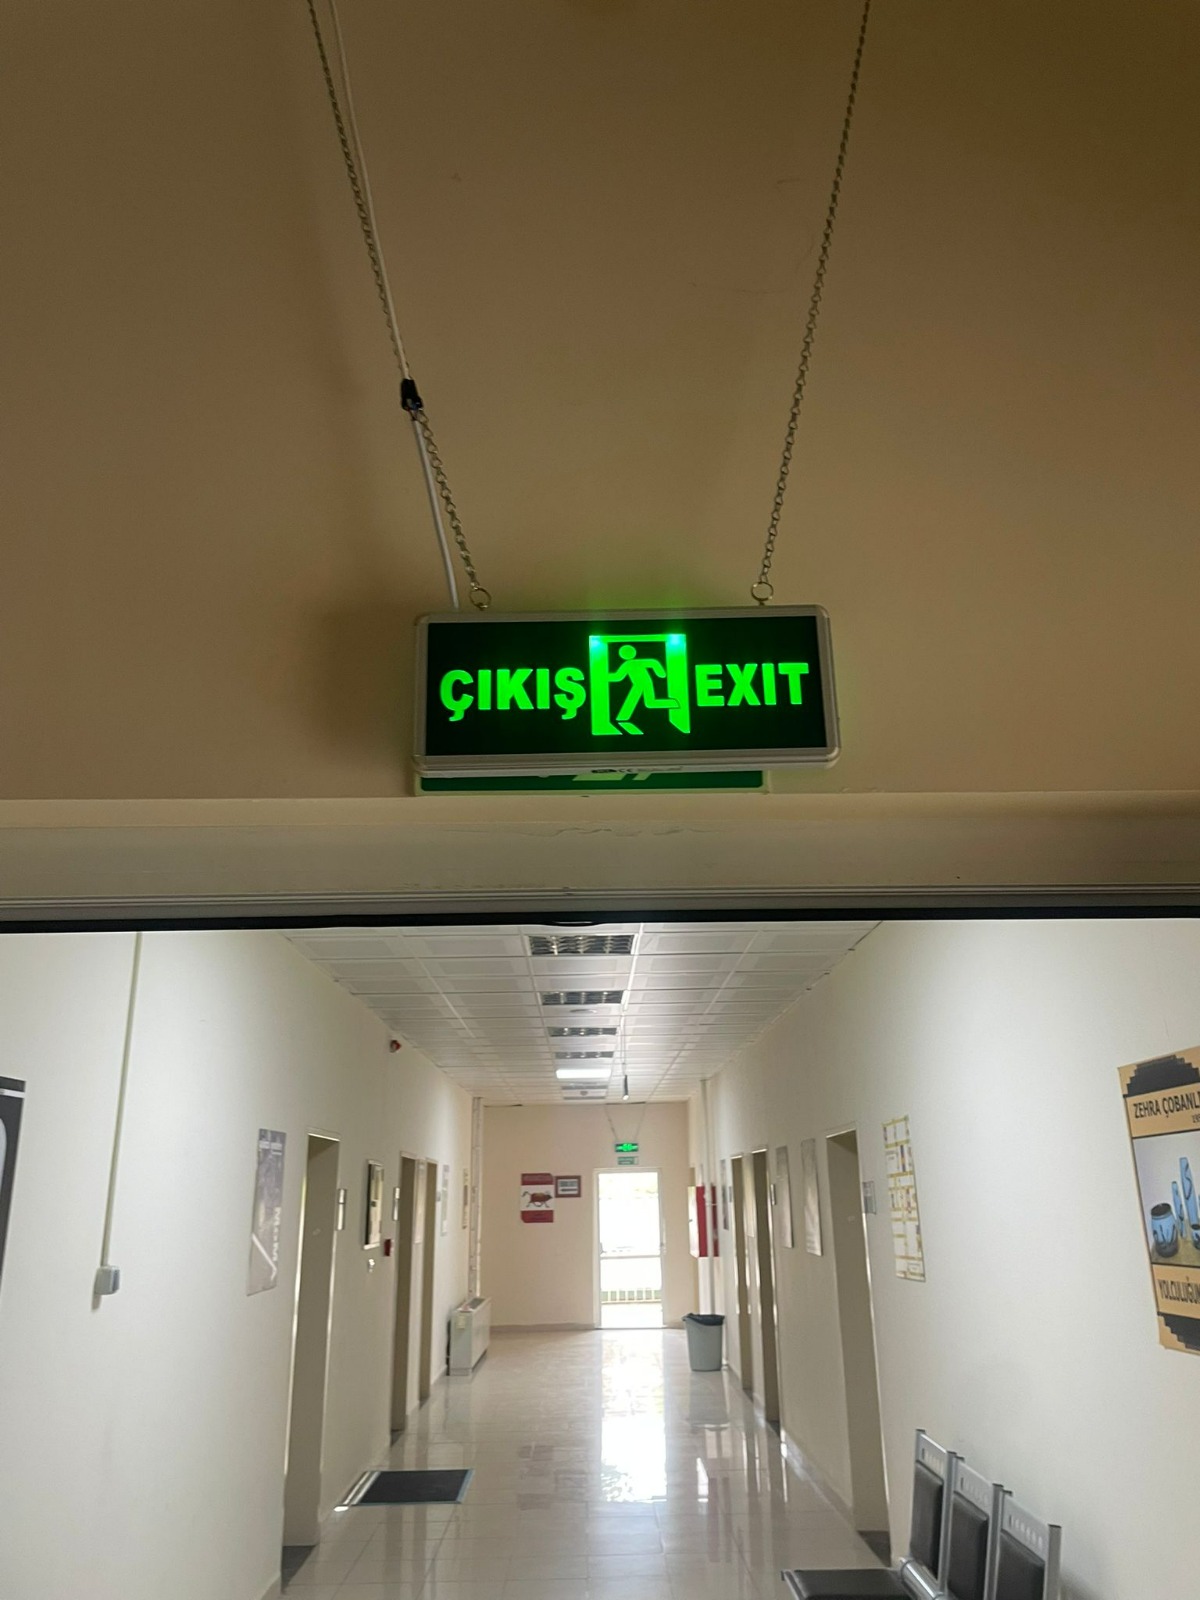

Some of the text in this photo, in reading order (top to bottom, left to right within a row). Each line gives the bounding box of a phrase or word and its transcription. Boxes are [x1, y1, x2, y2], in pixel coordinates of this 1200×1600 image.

[440, 662, 810, 722] ÇIKIŞ EXIT
[1133, 1097, 1161, 1119] ZEHRA
